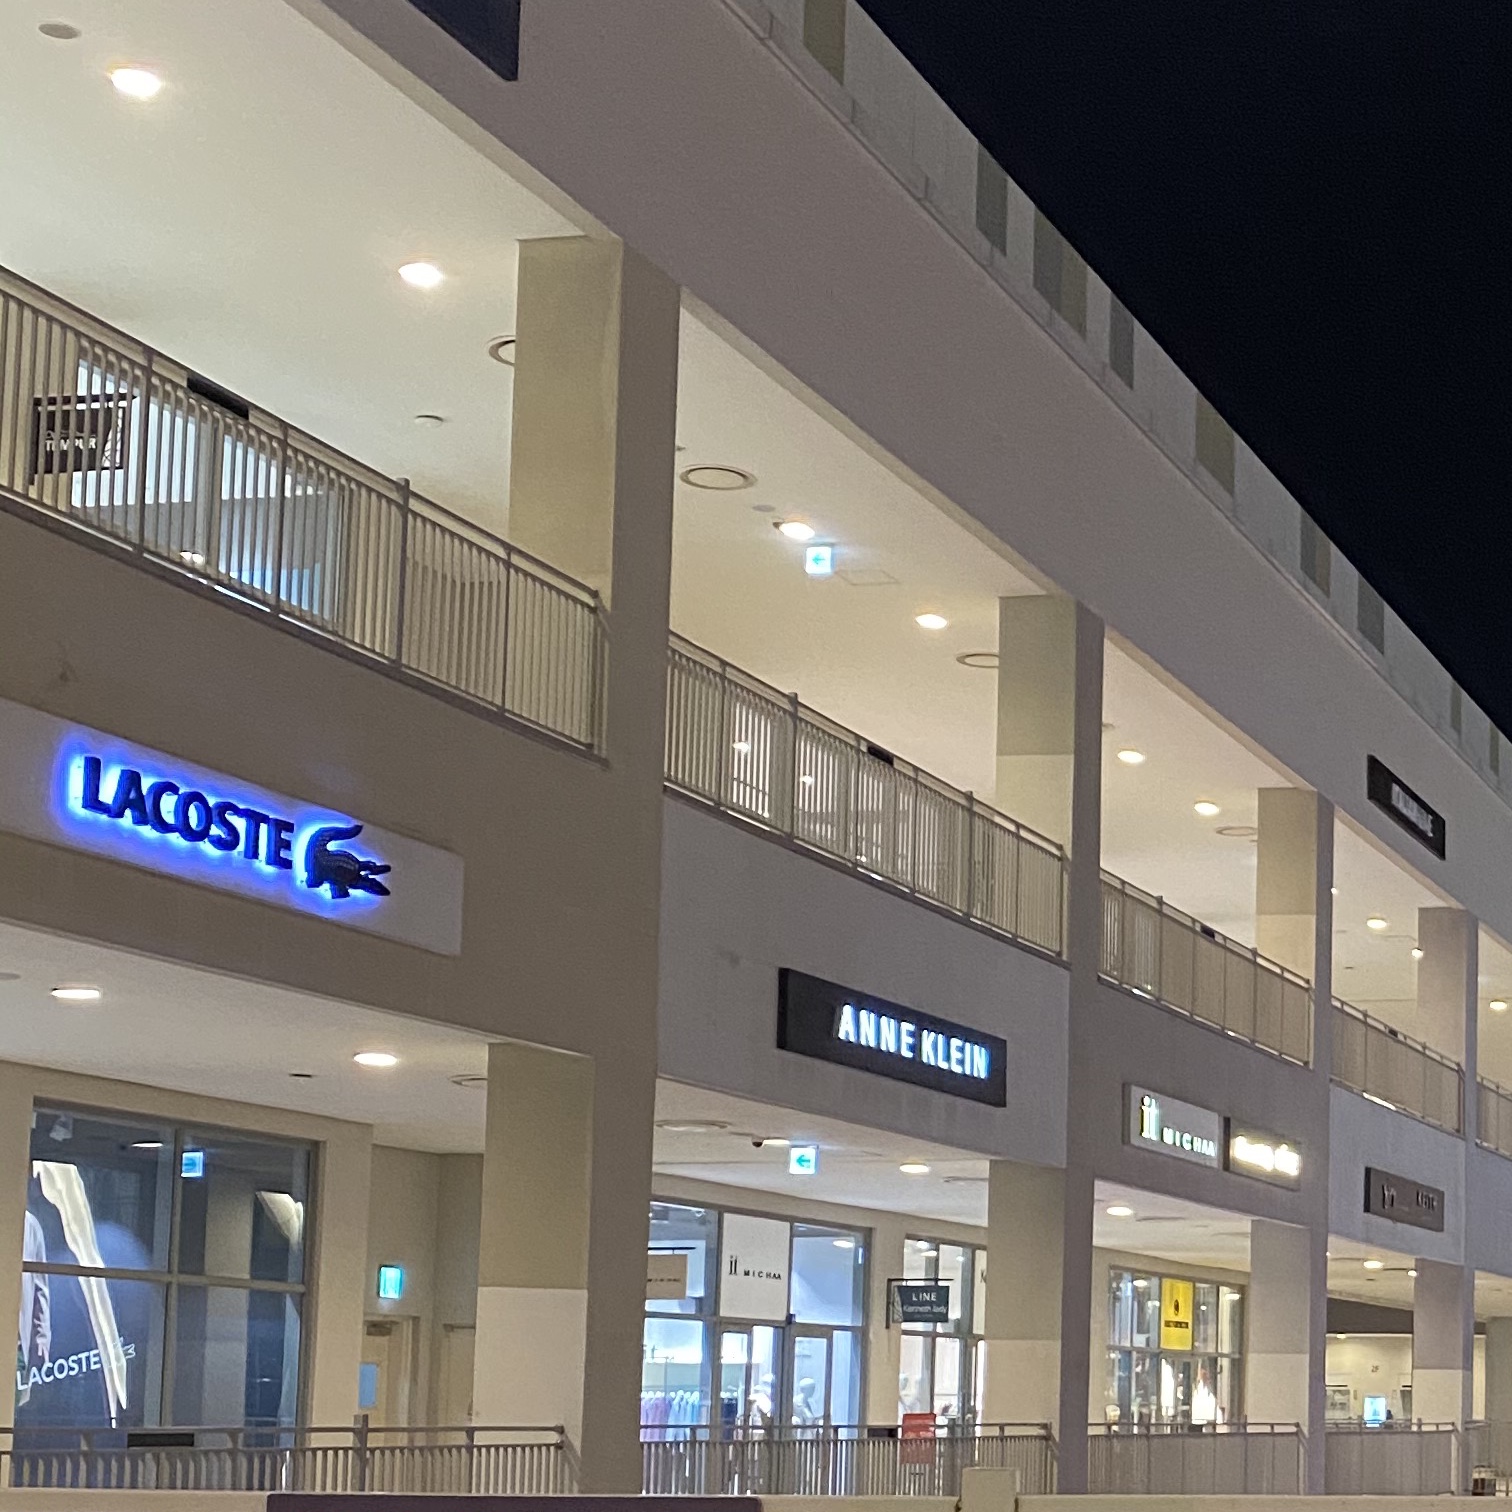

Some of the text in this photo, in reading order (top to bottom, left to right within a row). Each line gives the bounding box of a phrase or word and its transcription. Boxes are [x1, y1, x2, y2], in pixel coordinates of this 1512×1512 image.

[82, 756, 294, 870] LACOSTE
[837, 1003, 991, 1080] ANNE KLEIN
[1161, 1126, 1216, 1158] MICHAA
[743, 1269, 782, 1281] MICHAA
[911, 1292, 937, 1302] LINE
[16, 1348, 102, 1391] LACOSTE
